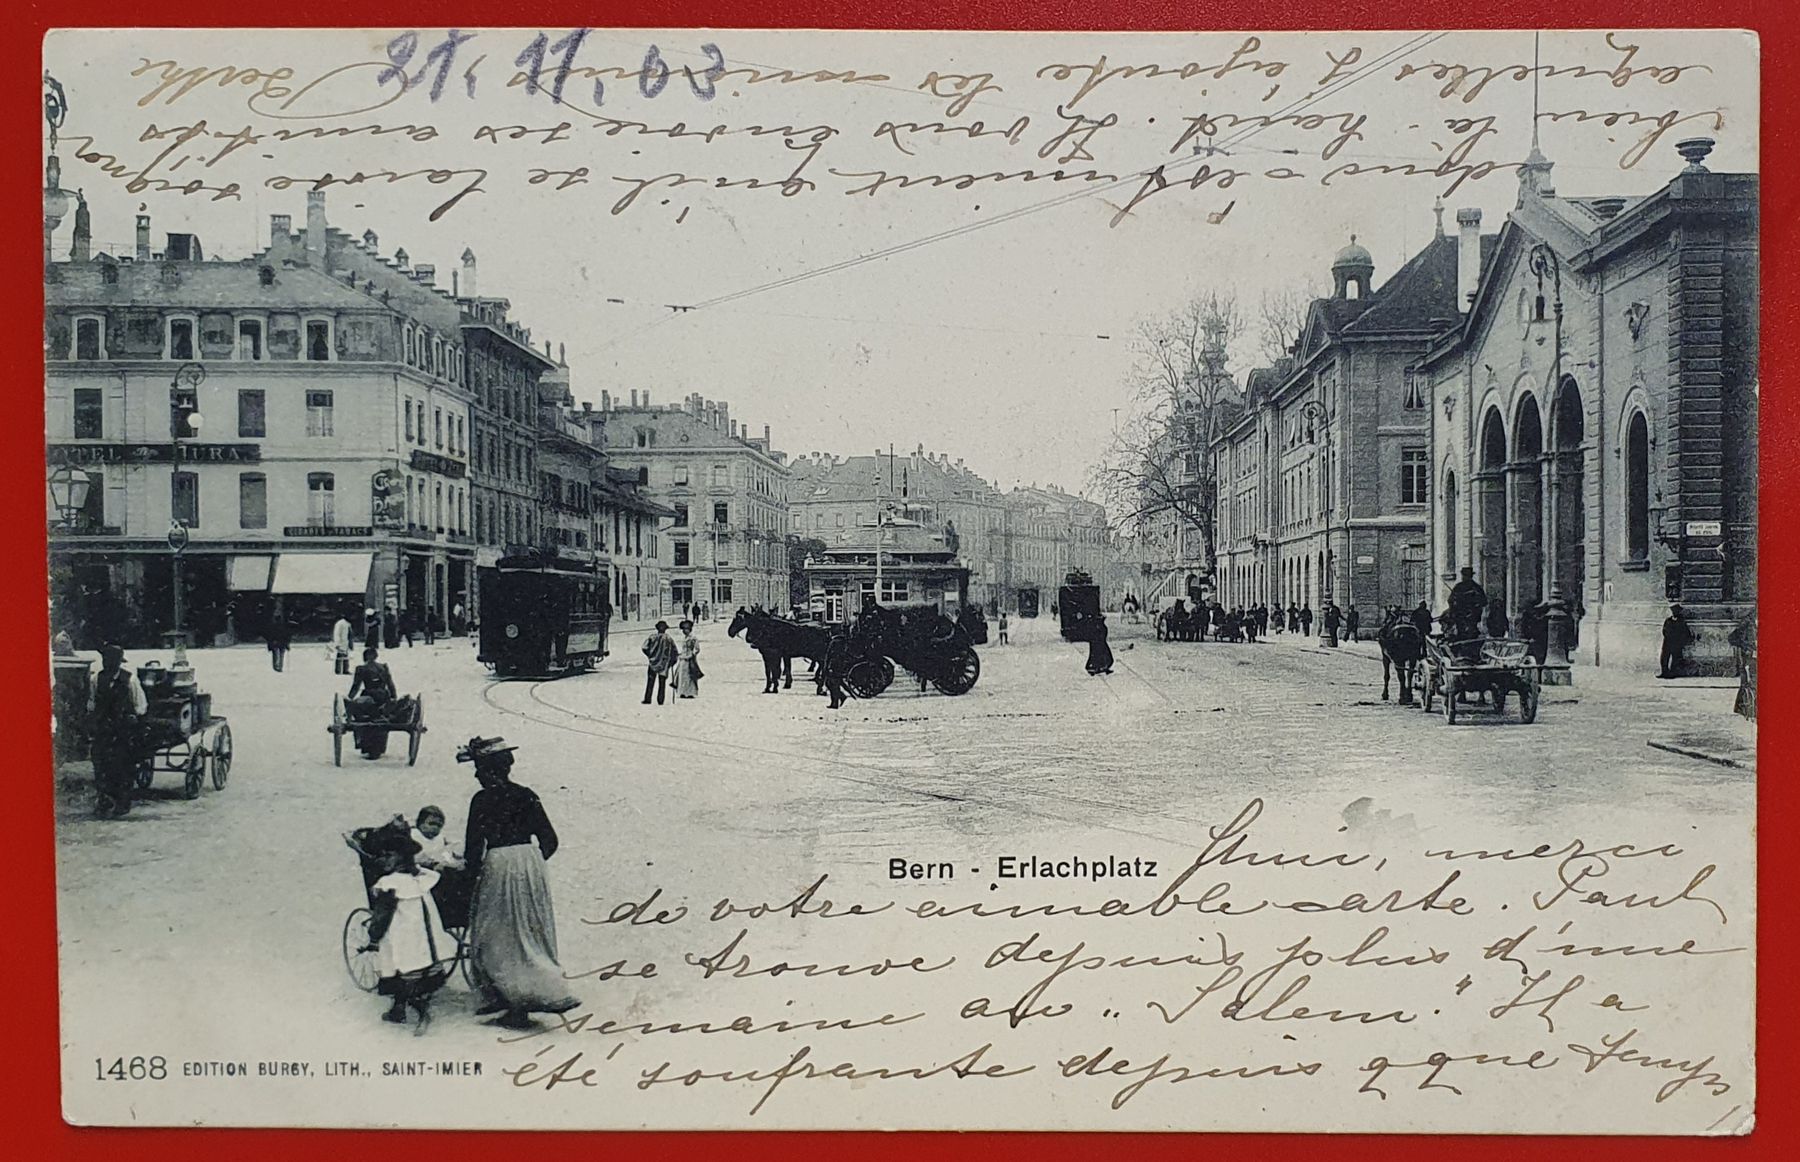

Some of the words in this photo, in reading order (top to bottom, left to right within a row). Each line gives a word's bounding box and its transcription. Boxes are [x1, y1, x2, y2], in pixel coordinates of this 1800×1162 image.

[130, 57, 410, 119] Berthe
[917, 71, 1004, 118] les
[473, 120, 573, 145] ses
[593, 118, 840, 154] envoie
[873, 115, 1031, 156] vous
[1536, 109, 1724, 170] bien
[264, 166, 489, 222] laisse
[528, 167, 590, 191] se
[1424, 824, 1700, 868] merci
[581, 887, 692, 927] de
[710, 873, 898, 919] votre
[904, 876, 1268, 918] aimable
[1533, 850, 1729, 925] Paul
[562, 952, 660, 981] se
[684, 928, 960, 980] trouve
[1239, 926, 1450, 996] plus
[497, 999, 928, 1044] semaine
[1596, 991, 1652, 1012] a
[501, 1043, 628, 1091] été
[1059, 1035, 1324, 1112] depuis
